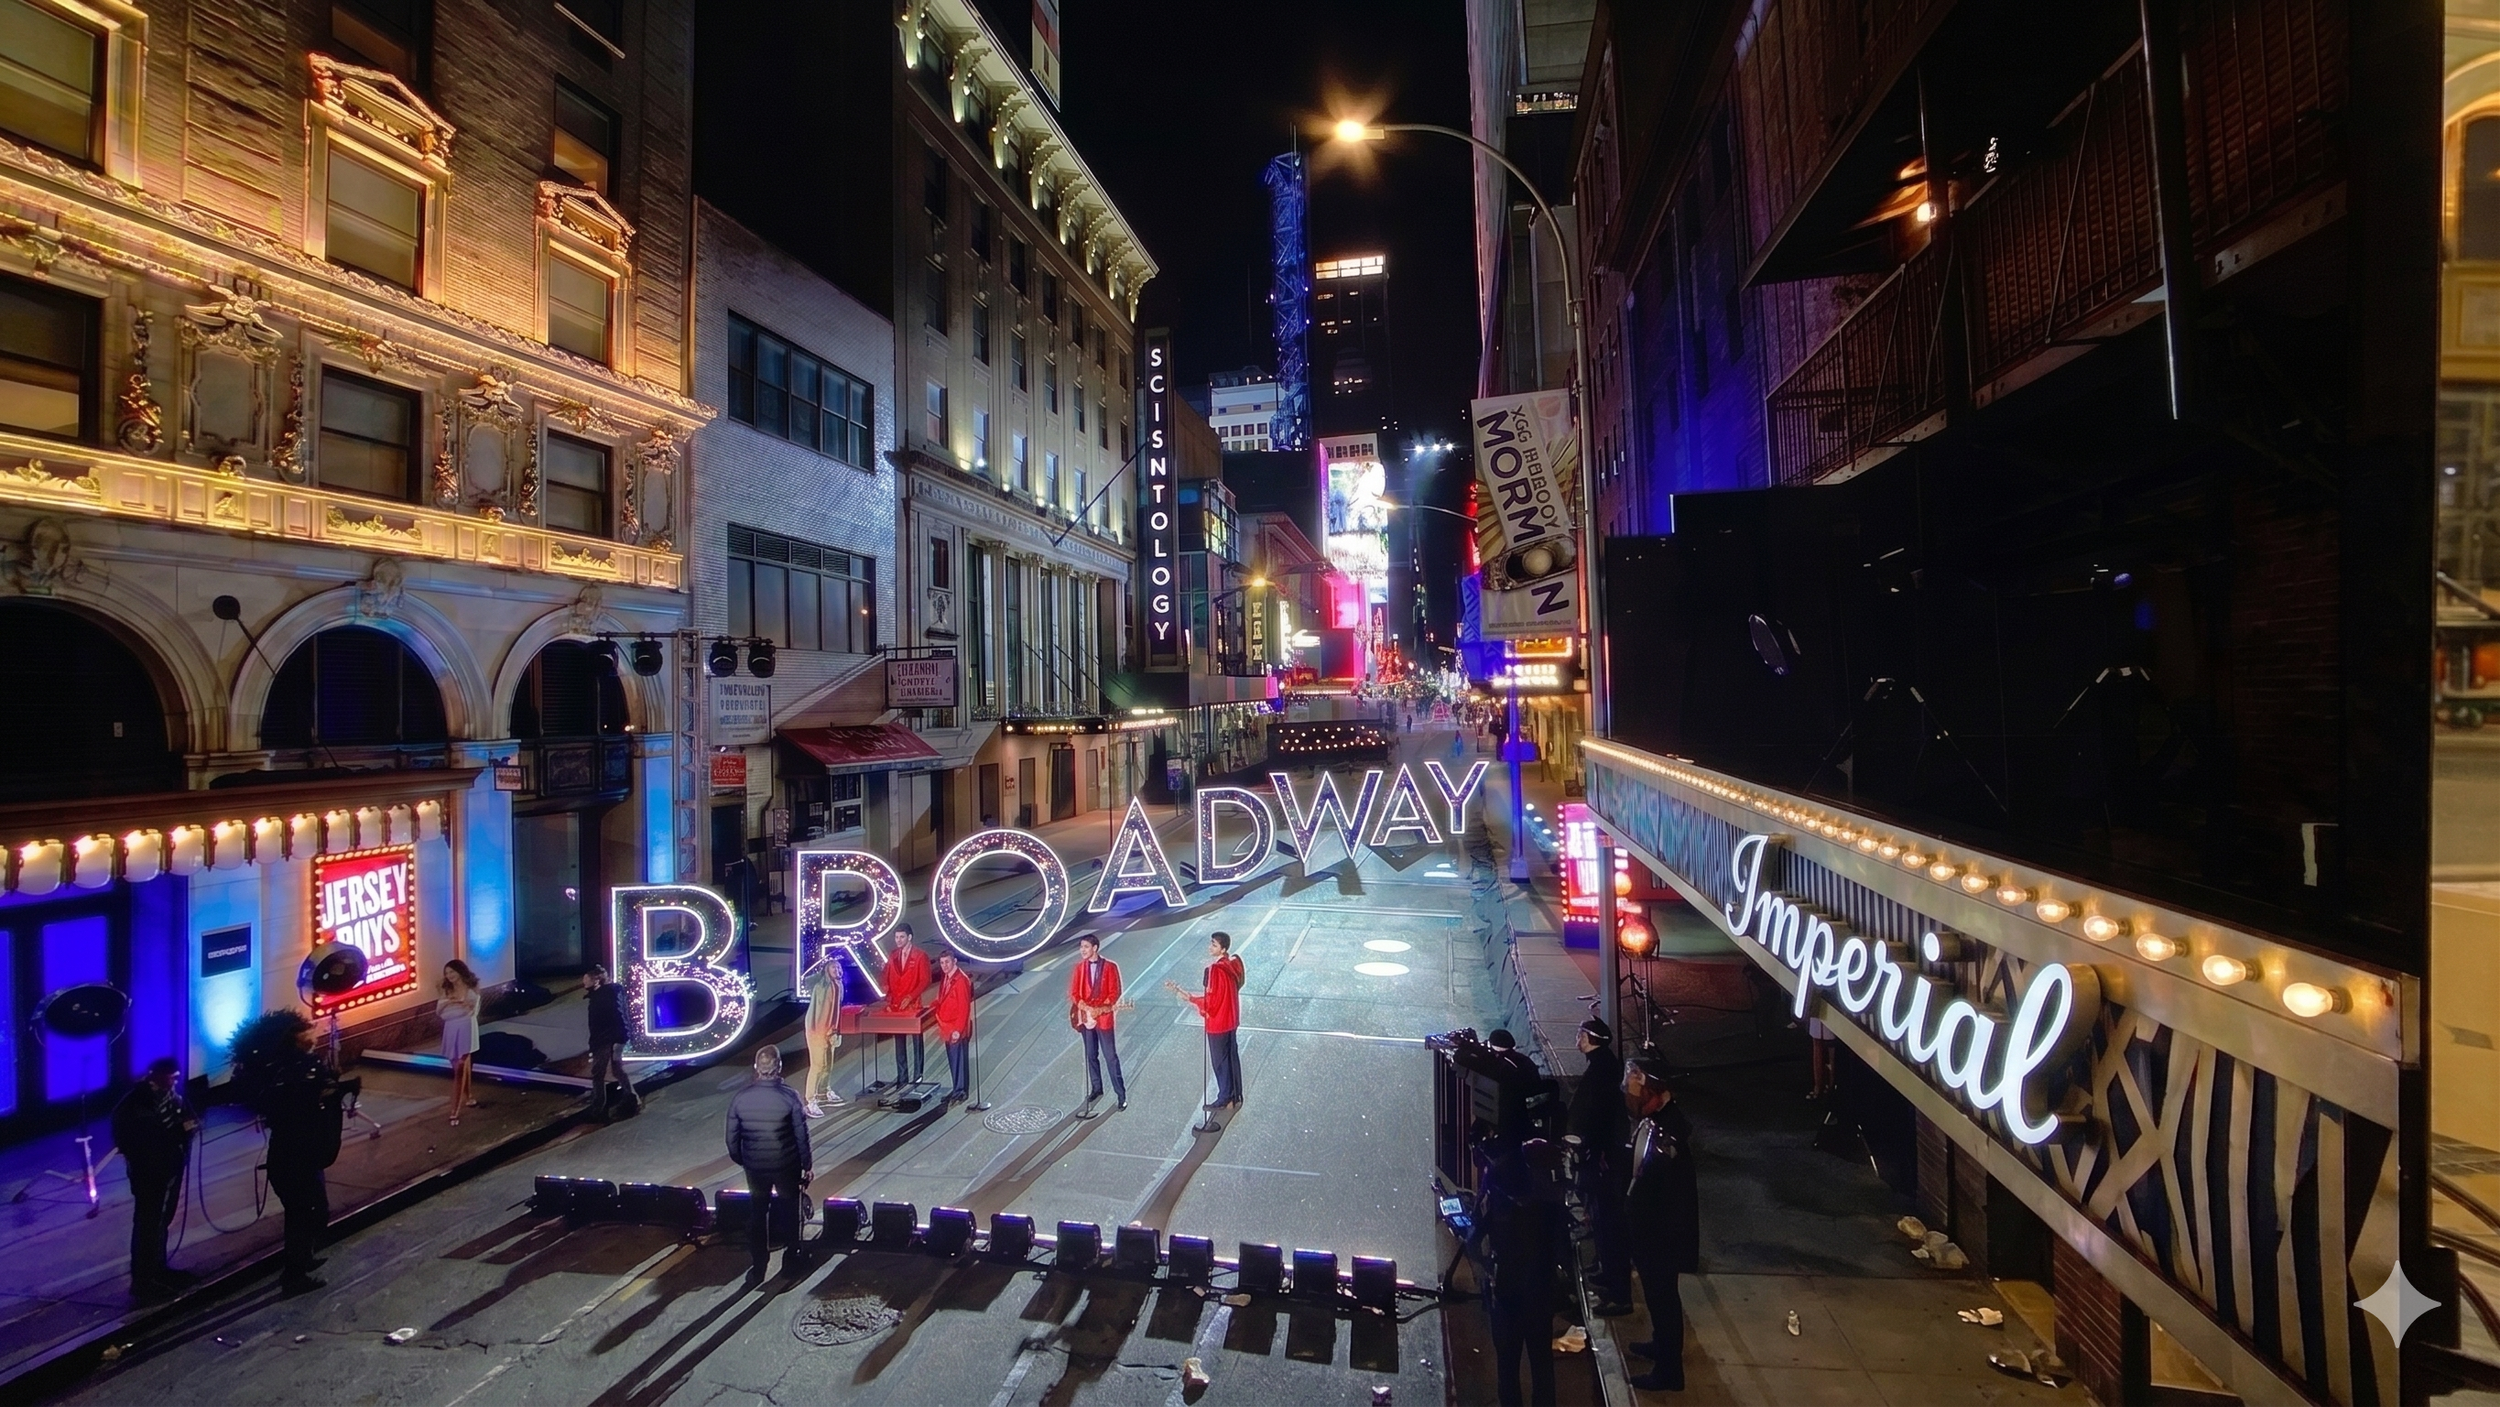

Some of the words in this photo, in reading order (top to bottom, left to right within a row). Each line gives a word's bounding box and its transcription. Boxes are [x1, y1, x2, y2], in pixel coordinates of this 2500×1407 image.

[1149, 347, 1171, 641] SCISNTOLOGY
[1476, 409, 1570, 616] MORMN
[321, 862, 407, 930] JERSEY
[611, 759, 1490, 1061] BROADWAY
[1726, 833, 2074, 1146] Imperial
